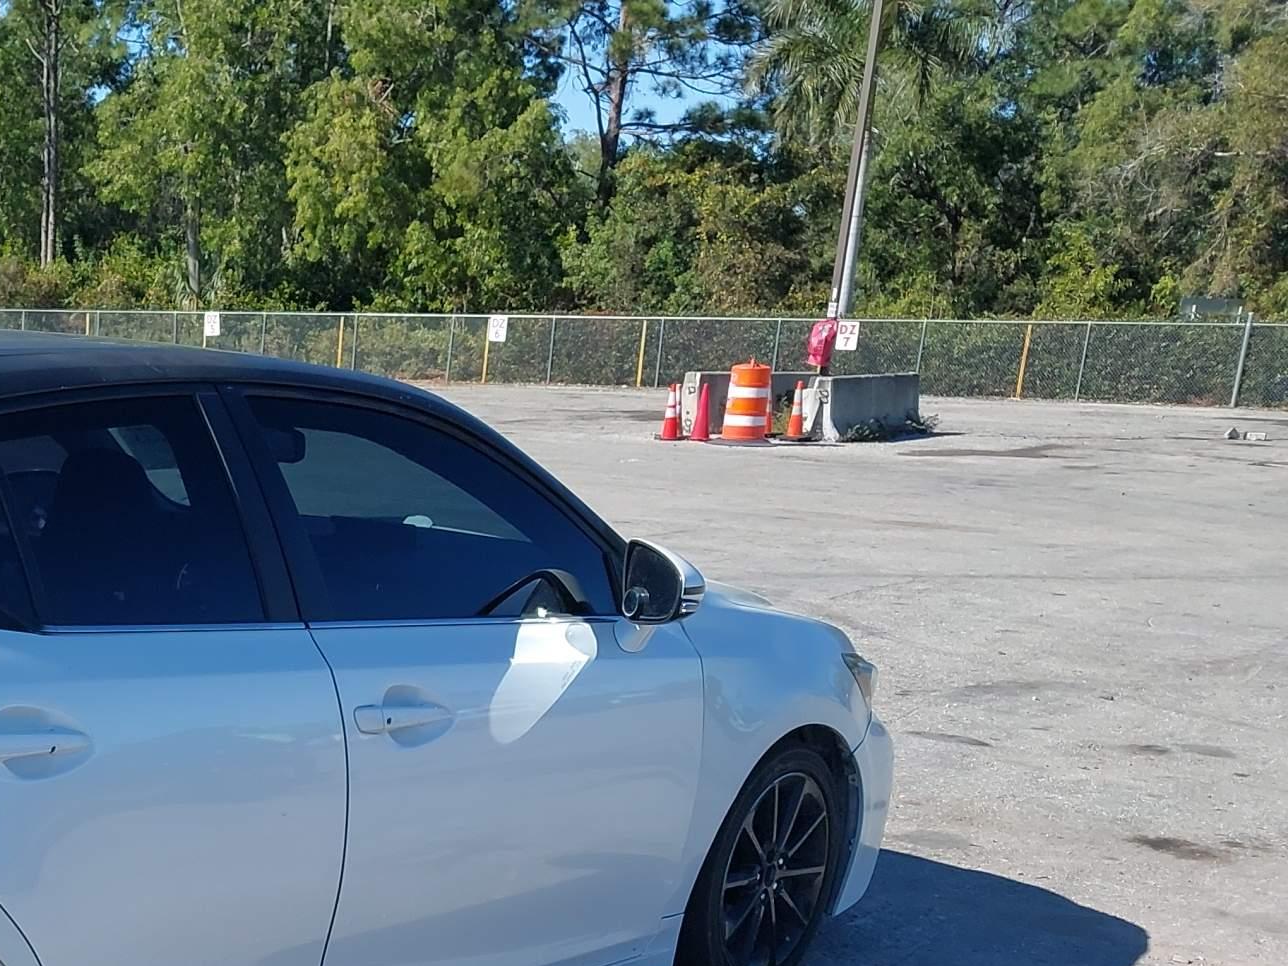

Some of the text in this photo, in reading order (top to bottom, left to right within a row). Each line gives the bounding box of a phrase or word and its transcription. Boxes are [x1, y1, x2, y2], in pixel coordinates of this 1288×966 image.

[492, 318, 506, 329] DZ
[494, 329, 500, 339] 6
[839, 324, 857, 335] DZ
[843, 337, 851, 347] 7
